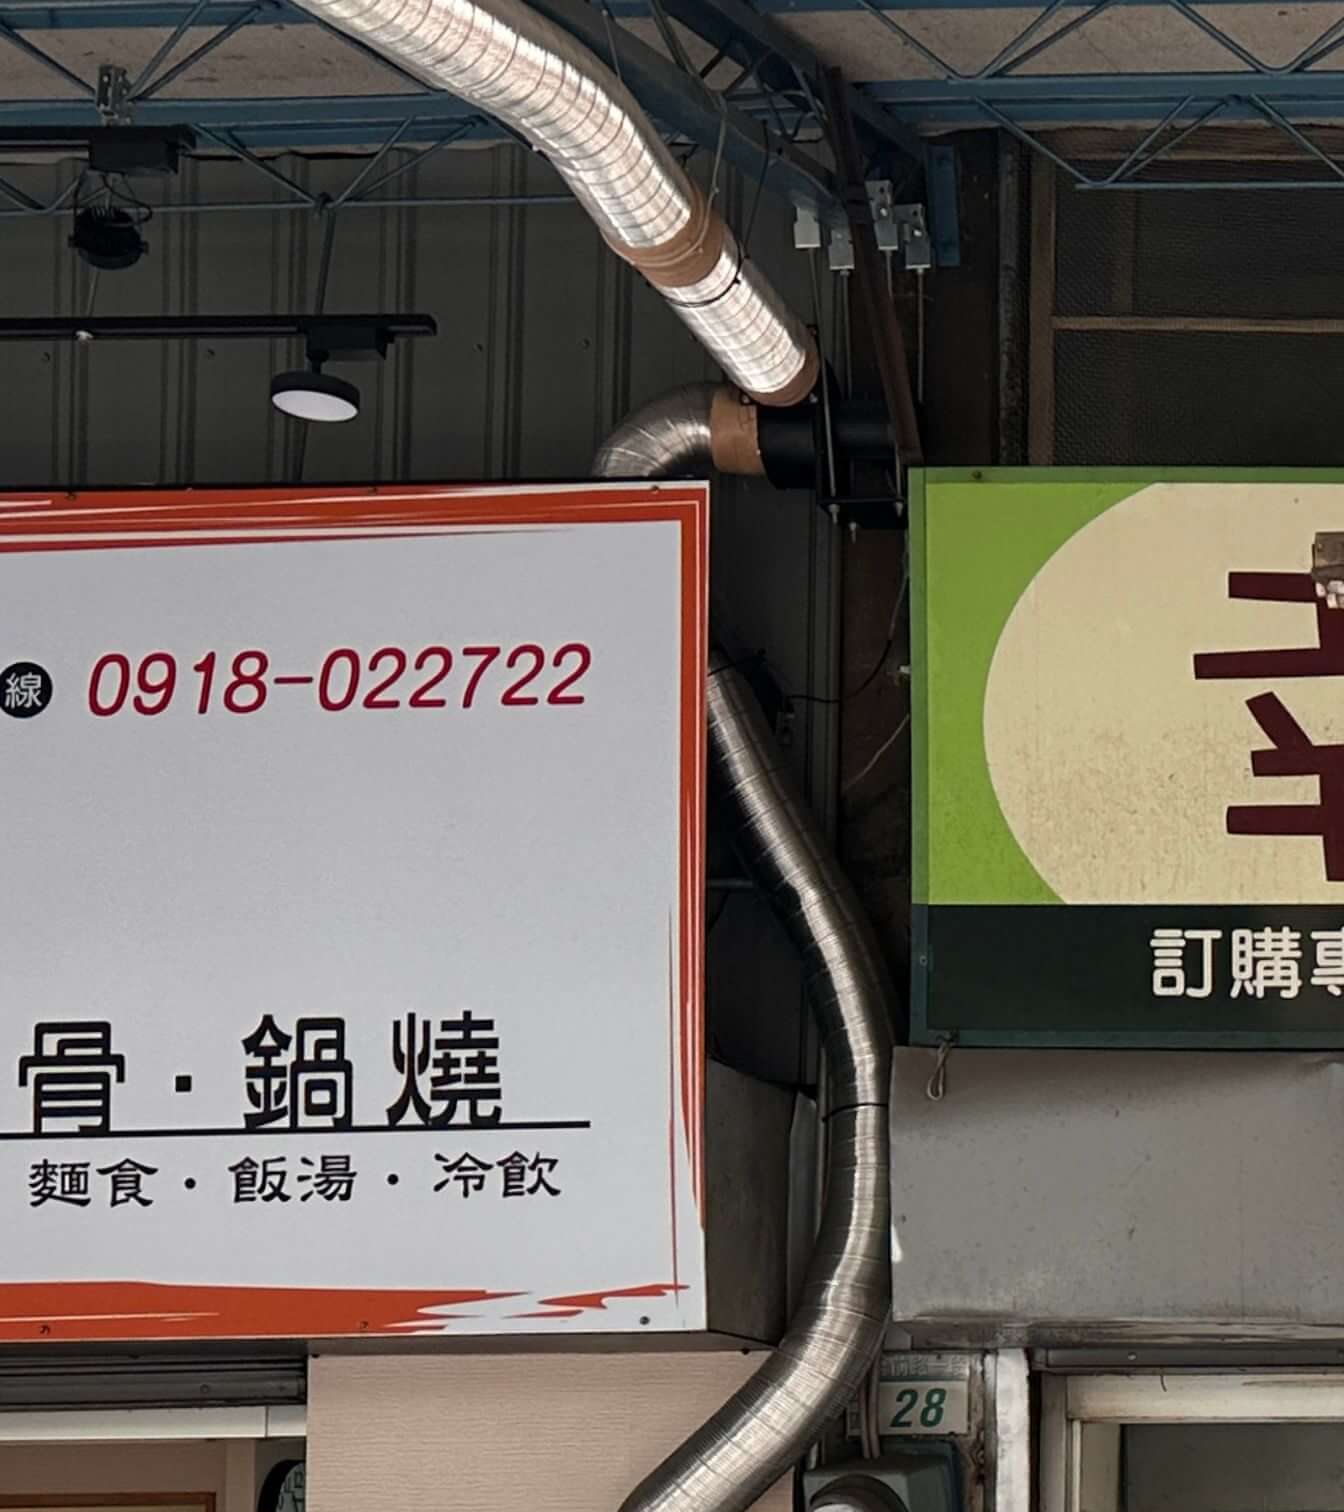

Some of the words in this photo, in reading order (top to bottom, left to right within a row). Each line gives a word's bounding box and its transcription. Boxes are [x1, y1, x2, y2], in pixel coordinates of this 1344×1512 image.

[3, 668, 44, 712] 線
[87, 642, 592, 717] 0918-022722
[889, 1387, 947, 1428] 28
